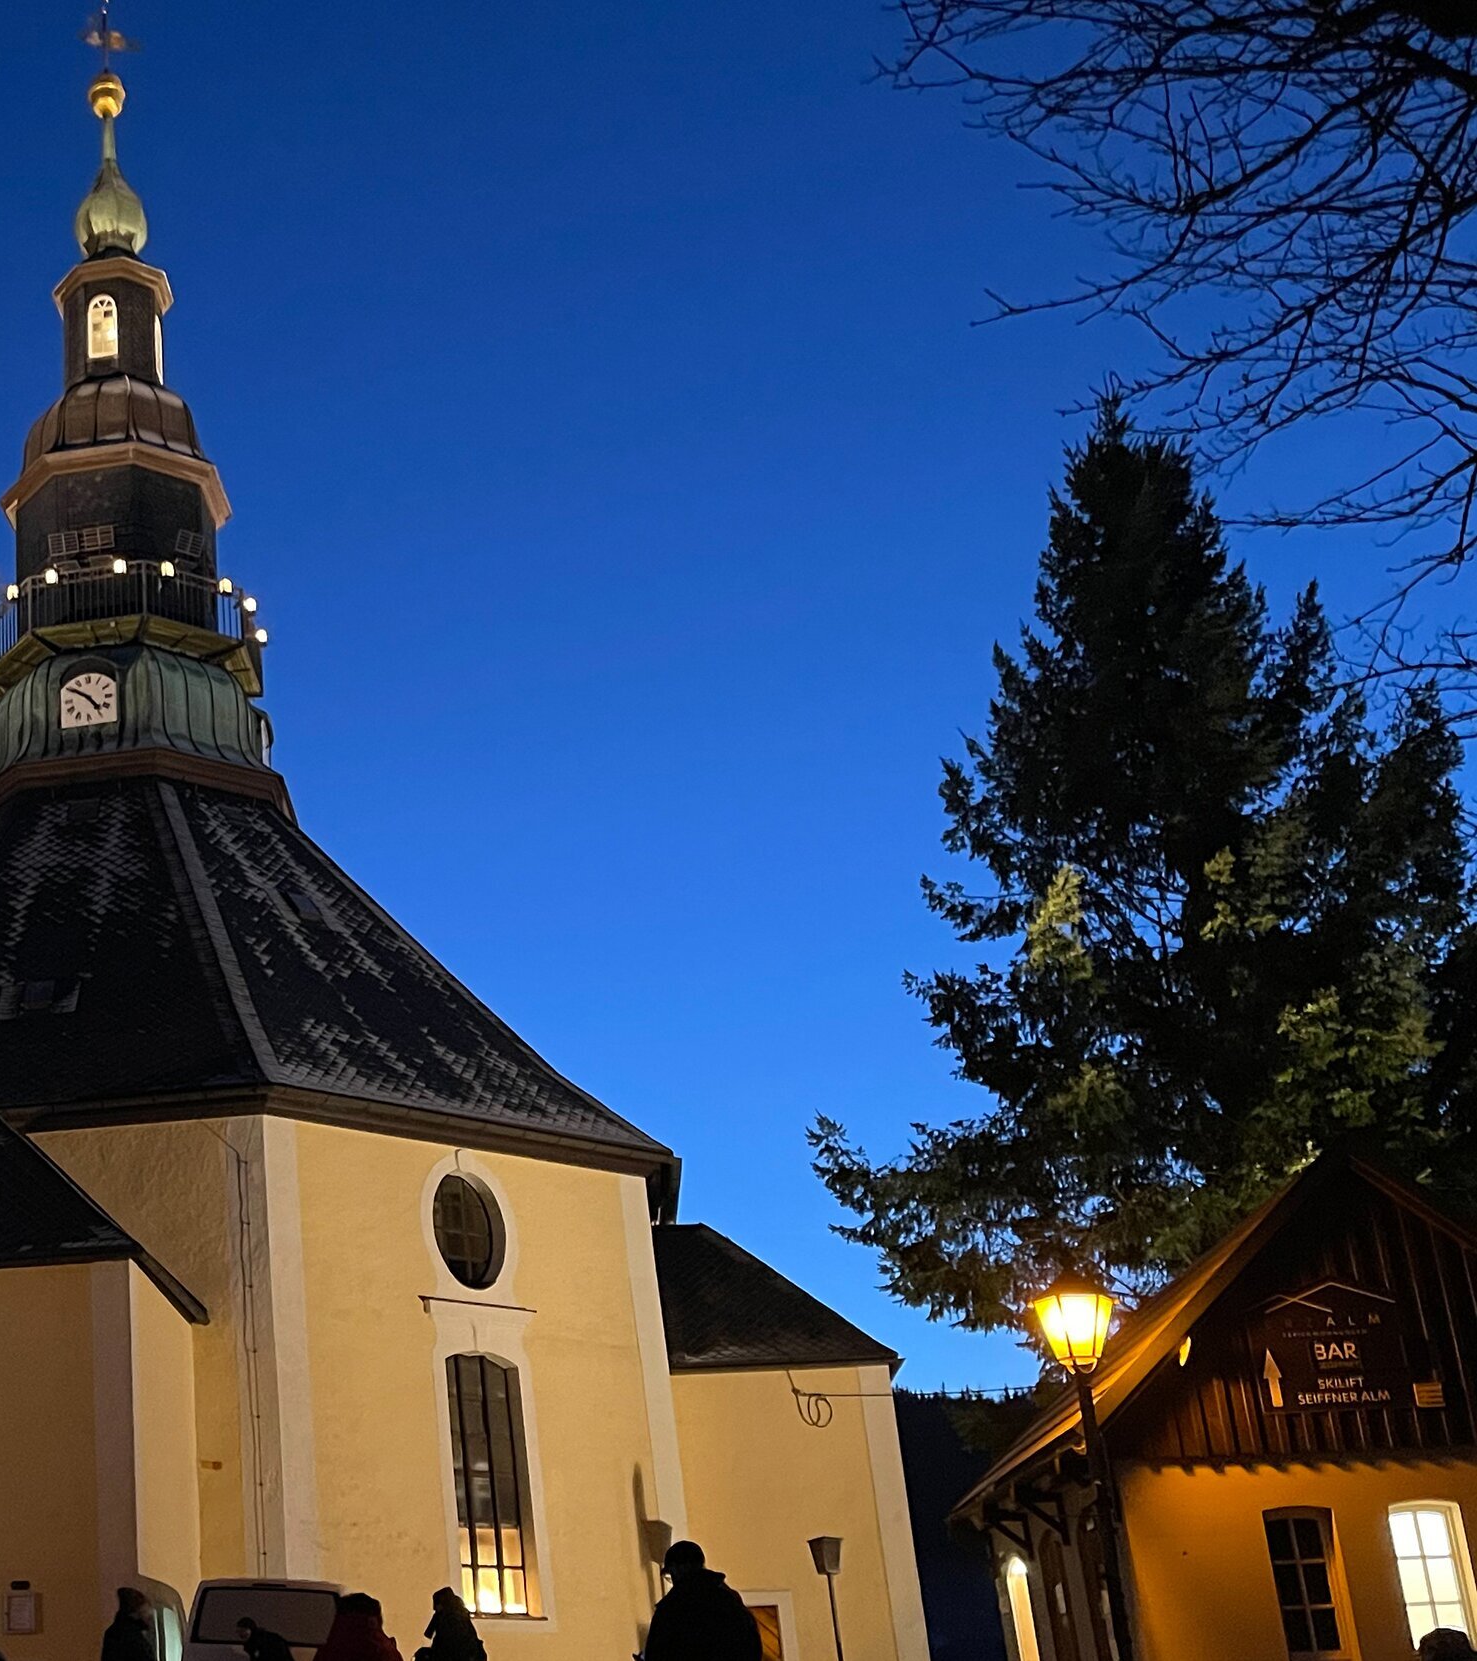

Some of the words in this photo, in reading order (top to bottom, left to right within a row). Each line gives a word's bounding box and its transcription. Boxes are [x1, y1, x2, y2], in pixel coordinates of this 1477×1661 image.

[1314, 1342, 1357, 1360] BAR
[1318, 1376, 1364, 1390] SKILIFT
[1298, 1392, 1359, 1405] SEIFFNER
[1361, 1390, 1390, 1403] ALM
